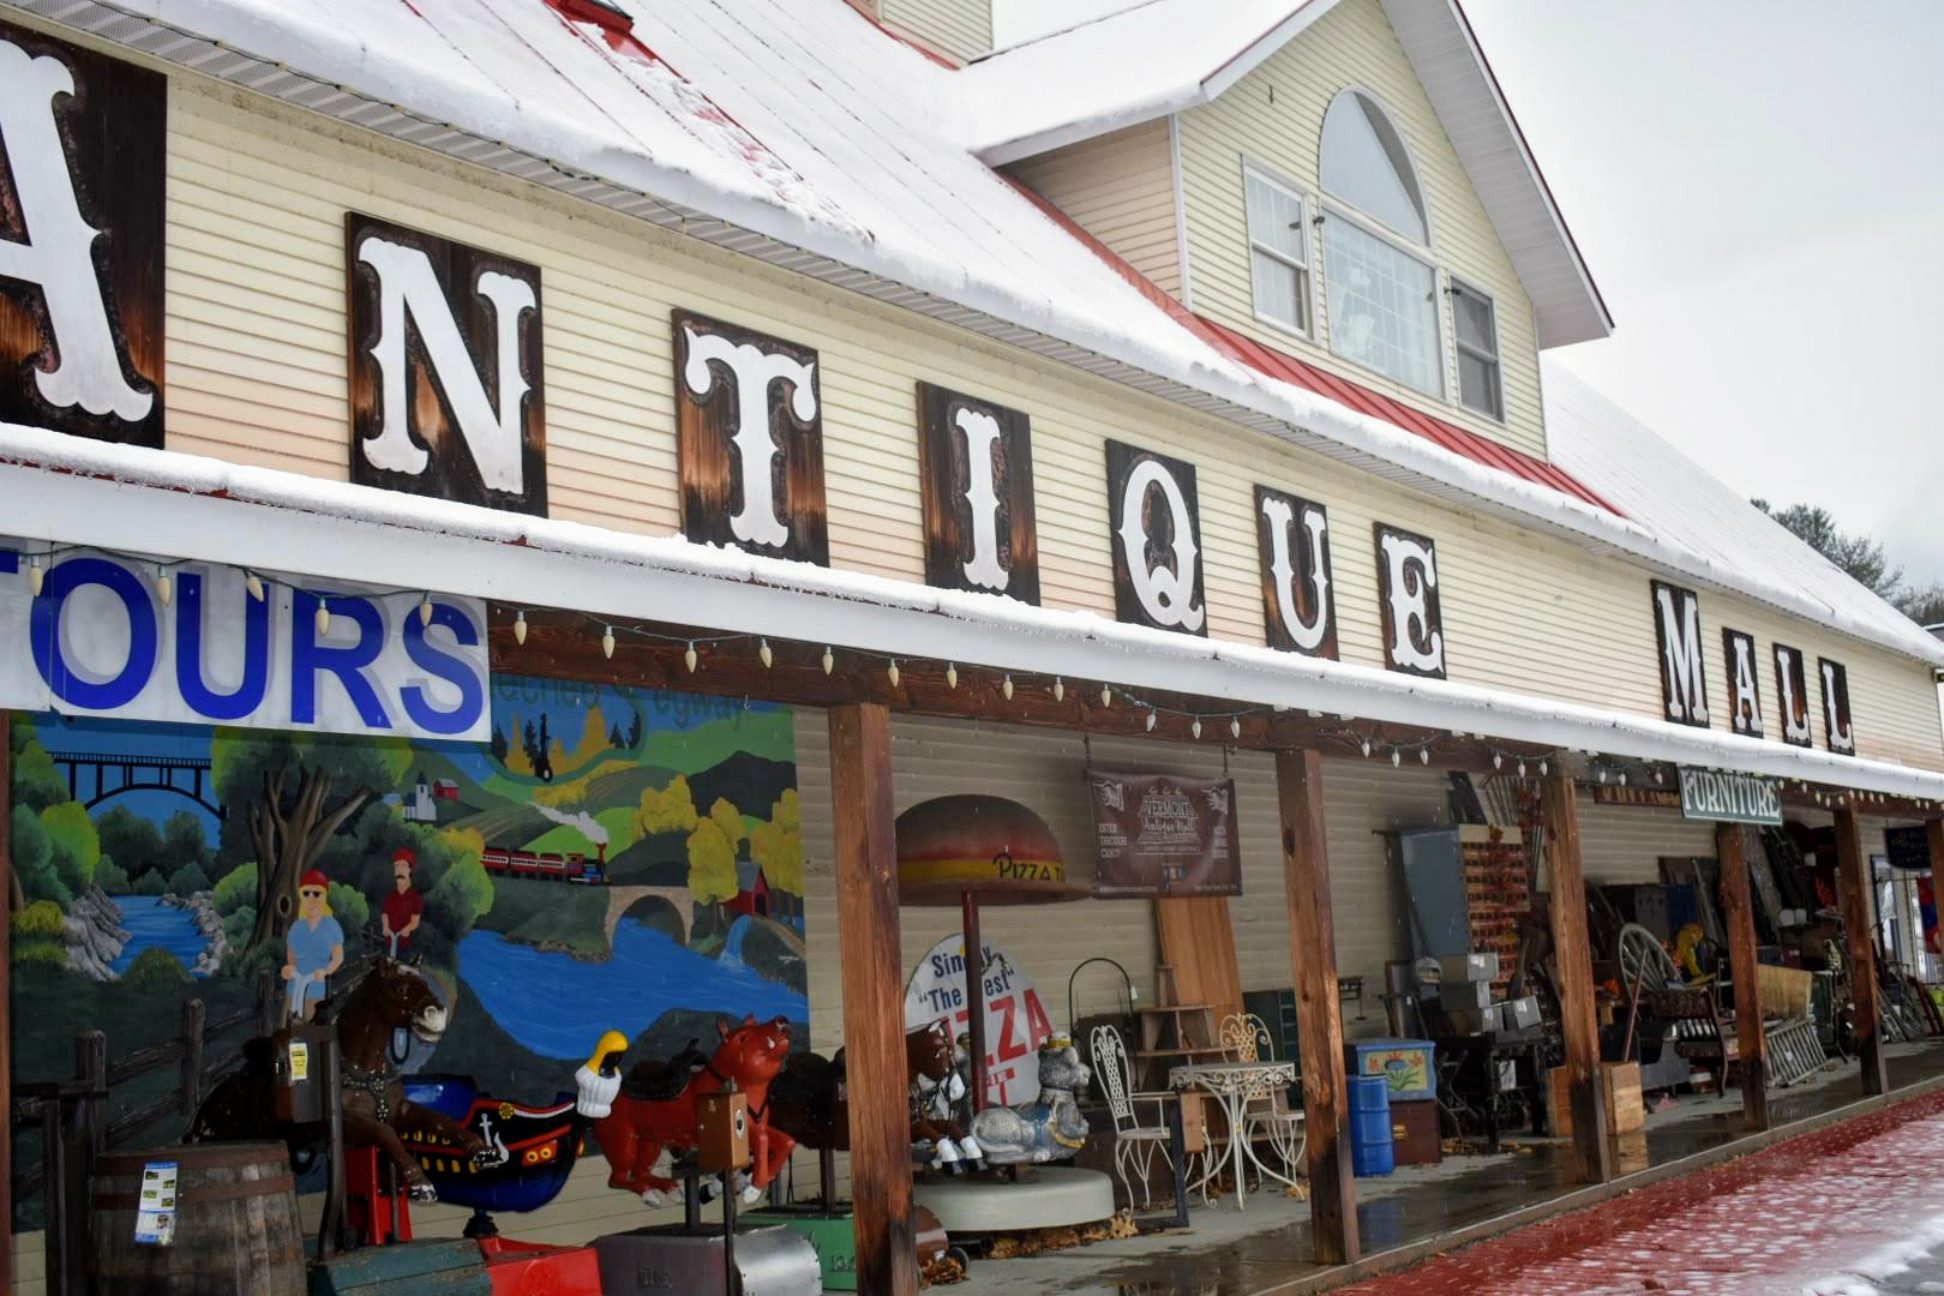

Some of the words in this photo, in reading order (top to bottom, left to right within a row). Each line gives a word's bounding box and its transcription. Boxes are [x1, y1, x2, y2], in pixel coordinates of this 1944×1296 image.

[0, 39, 1446, 672] ANTIQUE
[1655, 585, 1853, 750] MALL
[1680, 769, 1780, 819] FURNITURE
